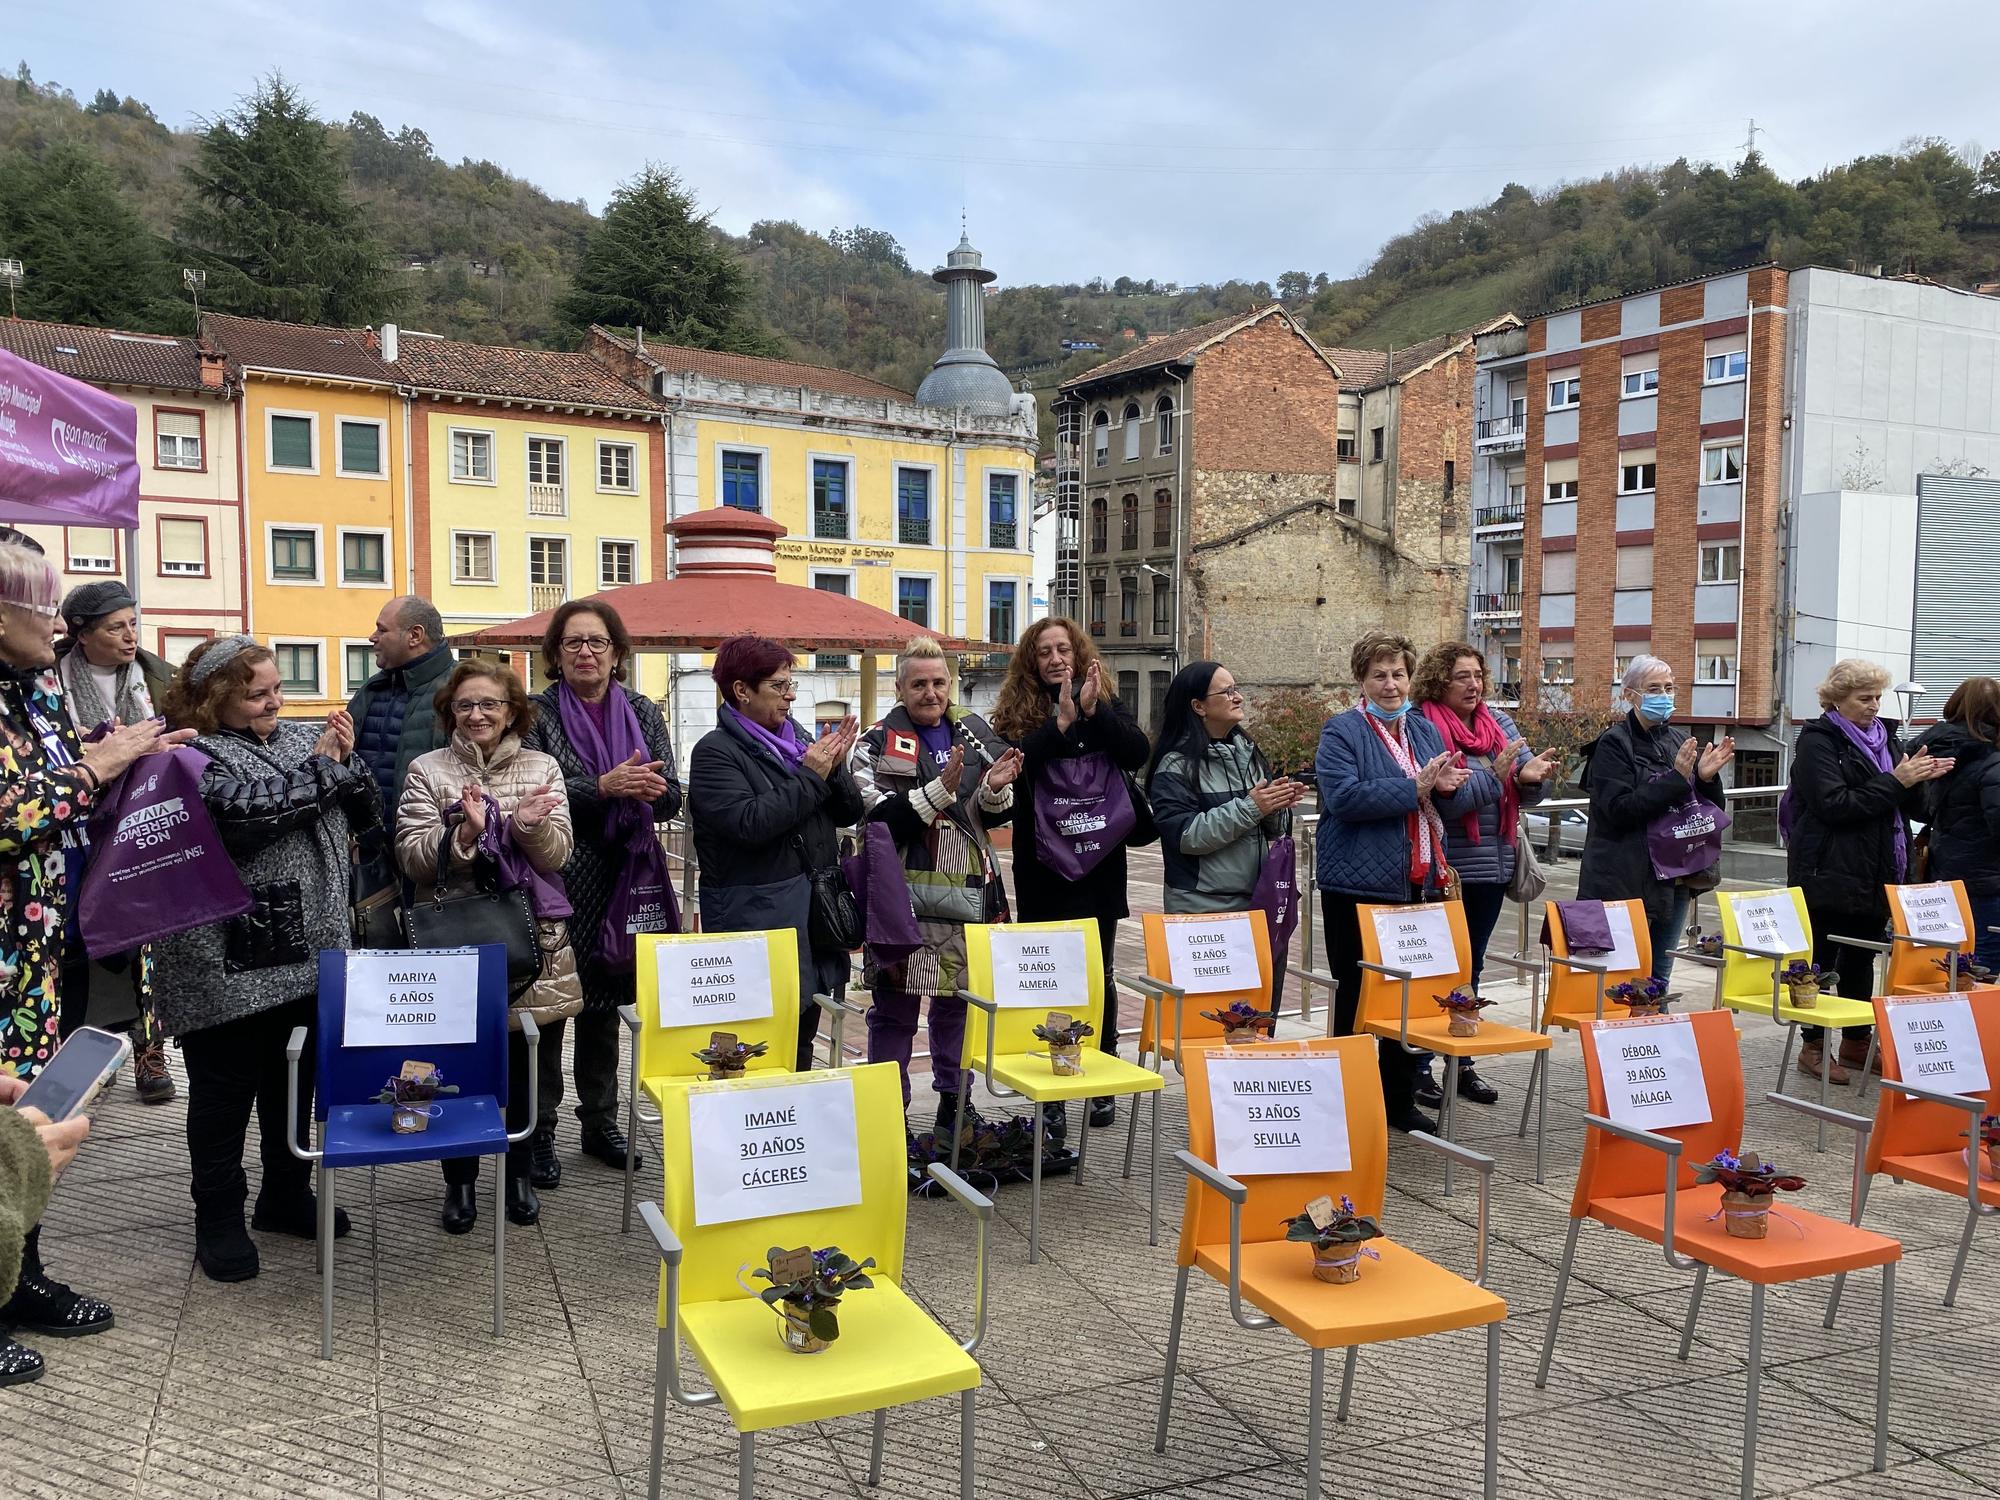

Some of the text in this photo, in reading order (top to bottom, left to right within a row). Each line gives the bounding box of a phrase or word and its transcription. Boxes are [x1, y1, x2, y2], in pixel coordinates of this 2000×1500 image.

[775, 544, 894, 559] ervicio Municipal de Empleo
[125, 804, 170, 827] VIVAS
[1056, 814, 1106, 827] QUEREMOS
[1069, 812, 1089, 820] NOS
[1686, 812, 1703, 824] NOS
[113, 811, 190, 846] QUEREMOS
[1067, 822, 1097, 834] VIVAS
[1672, 815, 1715, 831] QUEREMOS
[1683, 826, 1710, 837] VIVAS
[136, 830, 171, 849] NOS
[184, 845, 205, 860] 25N
[1921, 897, 1947, 905] CARMEN
[639, 902, 661, 913] NOS
[1923, 910, 1939, 918] AÑOS
[635, 920, 665, 931] VIVAS
[1399, 924, 1418, 933] SARA
[1918, 922, 1949, 931] ARCELONA
[1188, 933, 1225, 944] CLOTILDE
[1406, 938, 1427, 947] AÑOS
[1021, 945, 1050, 955] MAITE
[1192, 948, 1227, 960] 82 AÑOS
[690, 956, 733, 968] GEMMA
[1399, 952, 1433, 962] NAVARRA
[1018, 961, 1056, 972] 50 AÑOS
[1193, 965, 1231, 976] TENERIFE
[388, 972, 437, 983] MARIYA
[690, 973, 735, 986] 44 AÑOS
[1018, 978, 1058, 989] ALMERÍA
[389, 991, 434, 1003] 6 AÑOS
[692, 992, 736, 1005] MADRID
[386, 1013, 437, 1023] MADRID
[1907, 1020, 1944, 1031] Mª LUISA
[1622, 1044, 1661, 1058] DÉBORA
[1913, 1039, 1948, 1052] 68 AÑOS
[1626, 1066, 1666, 1081] 39 AÑOS
[1918, 1061, 1955, 1074] ALICANTE
[1233, 1080, 1312, 1093] MARI NIEVES
[1630, 1090, 1672, 1105] MÁLAGA
[744, 1106, 797, 1127] IMANÉ
[1248, 1104, 1300, 1119] 53 AÑOS
[1253, 1132, 1301, 1146] SEVILLA
[740, 1136, 805, 1157] 30 AÑOS
[742, 1166, 807, 1187] CÁCERES
